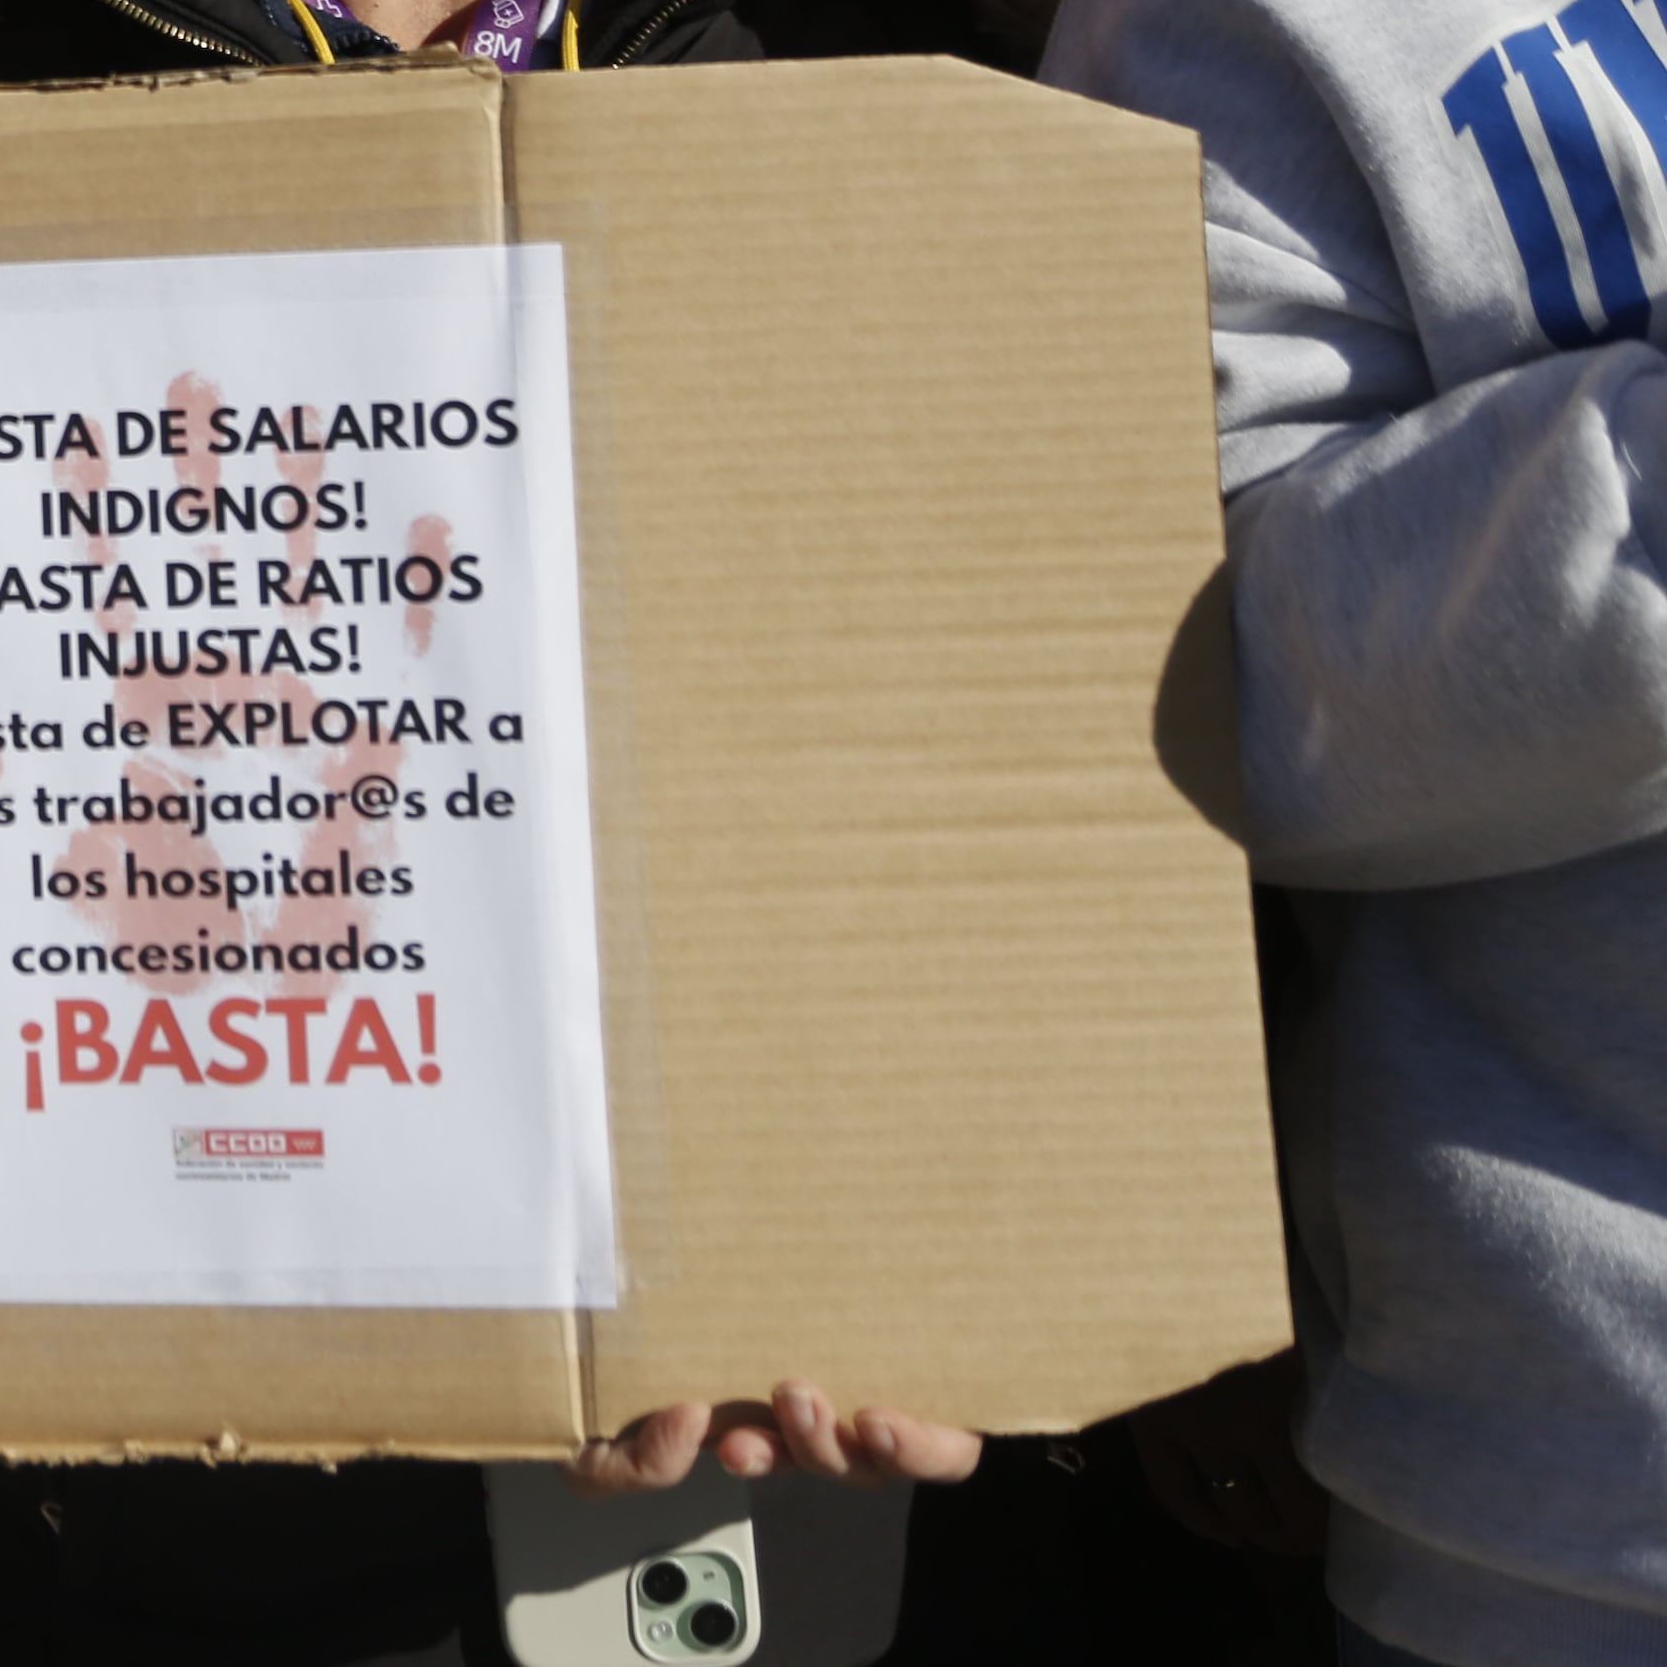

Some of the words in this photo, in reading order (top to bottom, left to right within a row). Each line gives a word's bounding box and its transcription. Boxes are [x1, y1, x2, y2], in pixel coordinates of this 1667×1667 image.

[474, 30, 523, 64] 8M
[116, 408, 189, 457] DE
[208, 399, 519, 455] SALARIOS
[41, 481, 368, 537] INDIGNOS!
[166, 561, 237, 608] DE
[258, 554, 483, 607] RATIOS
[60, 625, 361, 680] INJUSTAS!
[83, 704, 149, 749] de
[168, 699, 470, 748] EXPLOTAR
[488, 713, 523, 742] a
[34, 774, 426, 836] trabajador@s
[445, 772, 515, 819] de
[31, 854, 107, 900] los
[126, 849, 414, 911] hospitales
[12, 925, 425, 975] concesionados
[21, 994, 441, 1111] ¡BASTA!
[210, 1133, 286, 1153] CCOO
